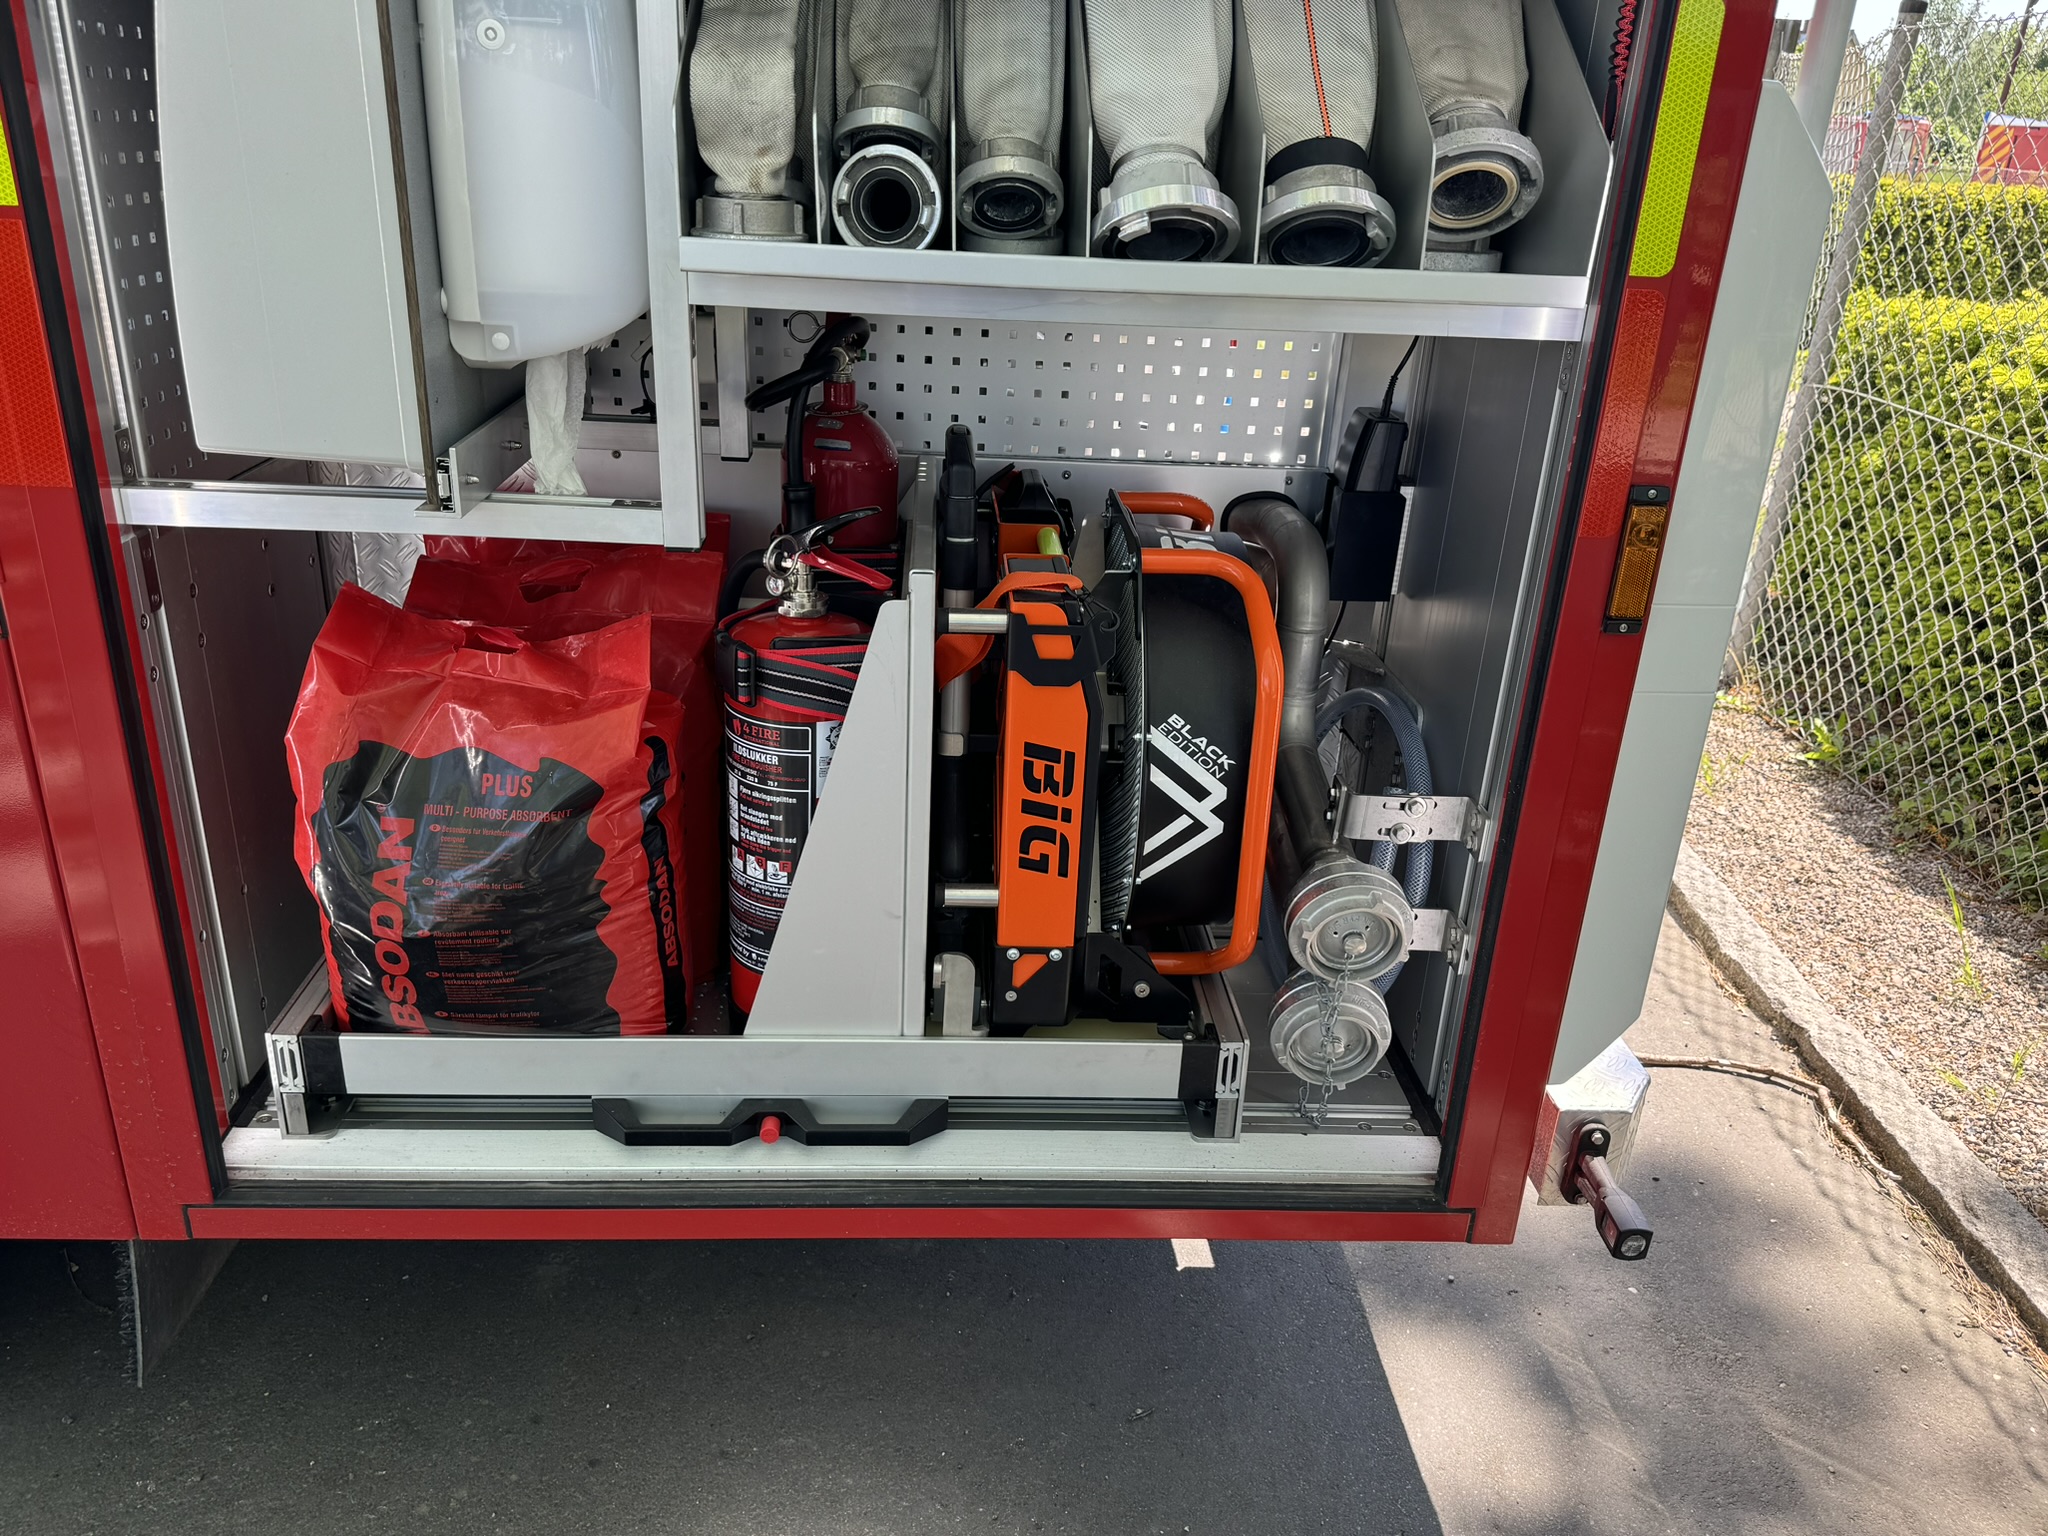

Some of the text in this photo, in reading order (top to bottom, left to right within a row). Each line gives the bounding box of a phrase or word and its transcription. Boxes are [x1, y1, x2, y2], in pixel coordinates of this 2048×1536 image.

[743, 723, 781, 741] 4 FIRE
[1157, 721, 1227, 780] EDITION
[1166, 713, 1238, 772] BLACK
[733, 743, 779, 765] ILDSLUKKER
[741, 757, 783, 774] EXTINGUISHER
[481, 773, 534, 798] PLUS
[751, 791, 797, 804] sikringssplitten
[423, 804, 454, 817] MULTI
[463, 807, 508, 821] PURPOSE
[510, 809, 573, 823] ABSORBENT
[441, 825, 472, 835] Besonders
[491, 882, 501, 890] for
[653, 855, 679, 967] ABSODAN
[370, 816, 432, 1034] BSODAN
[433, 929, 468, 938] Absorbant
[501, 928, 513, 936] sur
[473, 937, 500, 945] routiers
[475, 971, 503, 979] geschikt
